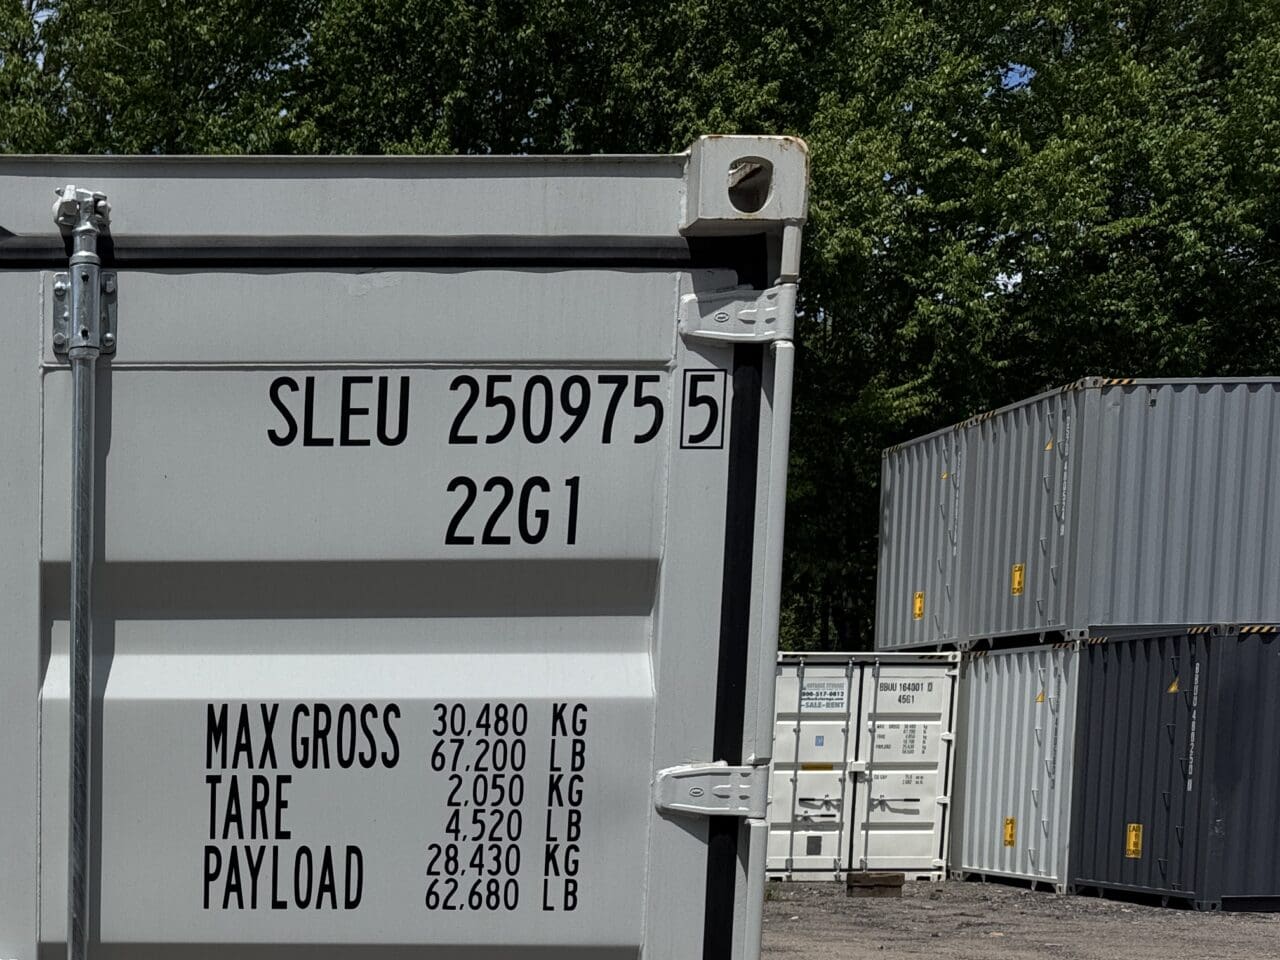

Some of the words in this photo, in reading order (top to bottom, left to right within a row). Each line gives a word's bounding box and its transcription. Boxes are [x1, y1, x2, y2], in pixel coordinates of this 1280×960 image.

[267, 375, 411, 447] SLEU
[448, 374, 665, 445] 250975
[685, 373, 722, 446] 5
[445, 476, 580, 545] 22G1
[206, 703, 279, 769] MAX
[290, 703, 401, 769] GROSS
[432, 703, 528, 737] 30,480
[551, 703, 588, 737] KG
[431, 738, 526, 772] 67,200
[550, 738, 586, 772] LB
[206, 775, 292, 840] TARE
[447, 774, 524, 808] 2,050
[548, 774, 584, 807] KG
[445, 809, 522, 843] 4,520
[545, 809, 582, 842] LB
[203, 845, 364, 910] PAYLOAD
[426, 843, 521, 878] 28,430
[544, 844, 580, 877] KG
[425, 878, 519, 912] 62,680
[542, 878, 578, 911] LB
